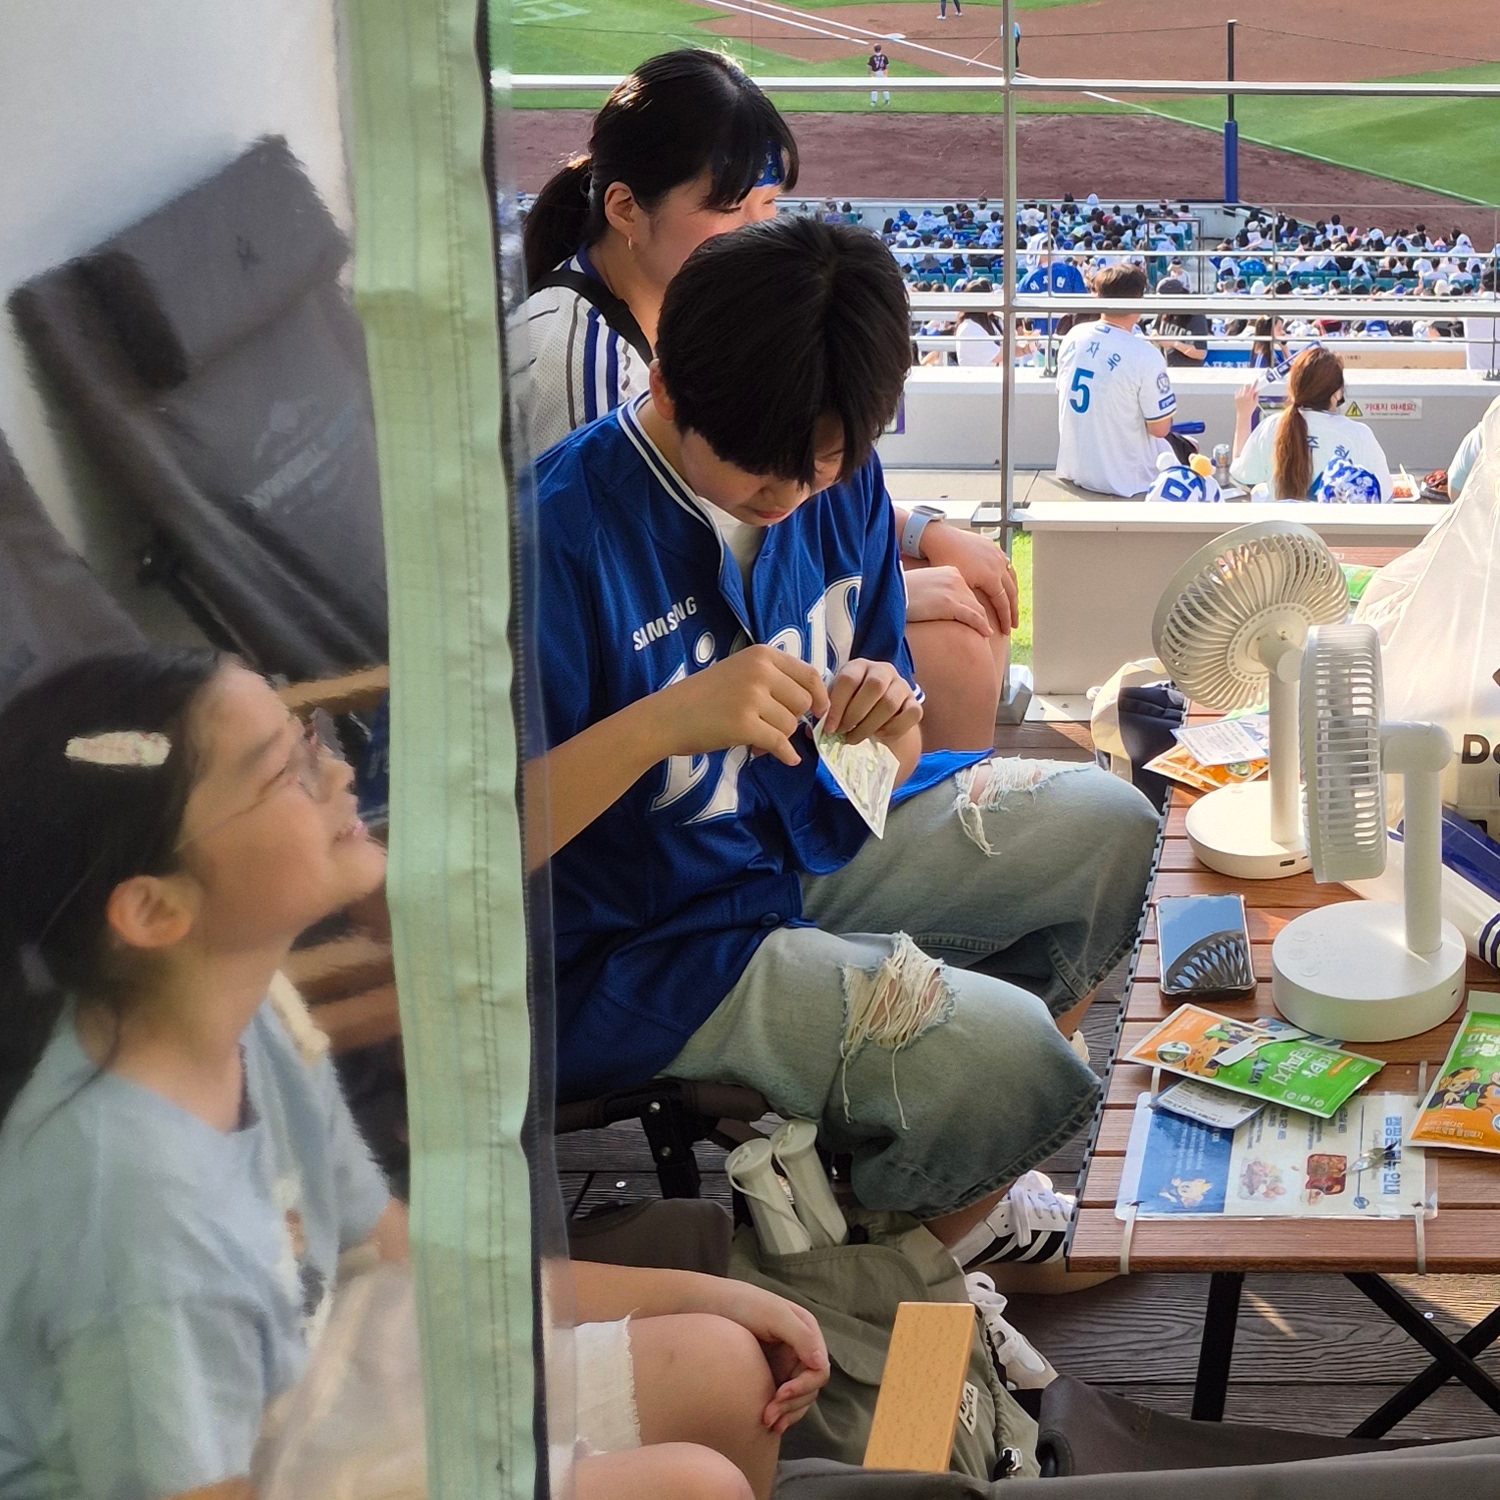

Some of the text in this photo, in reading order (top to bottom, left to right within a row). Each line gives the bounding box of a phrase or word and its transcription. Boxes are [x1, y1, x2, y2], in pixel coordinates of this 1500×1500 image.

[1069, 367, 1095, 414] 5
[1365, 403, 1417, 412] 기대지 마세요!
